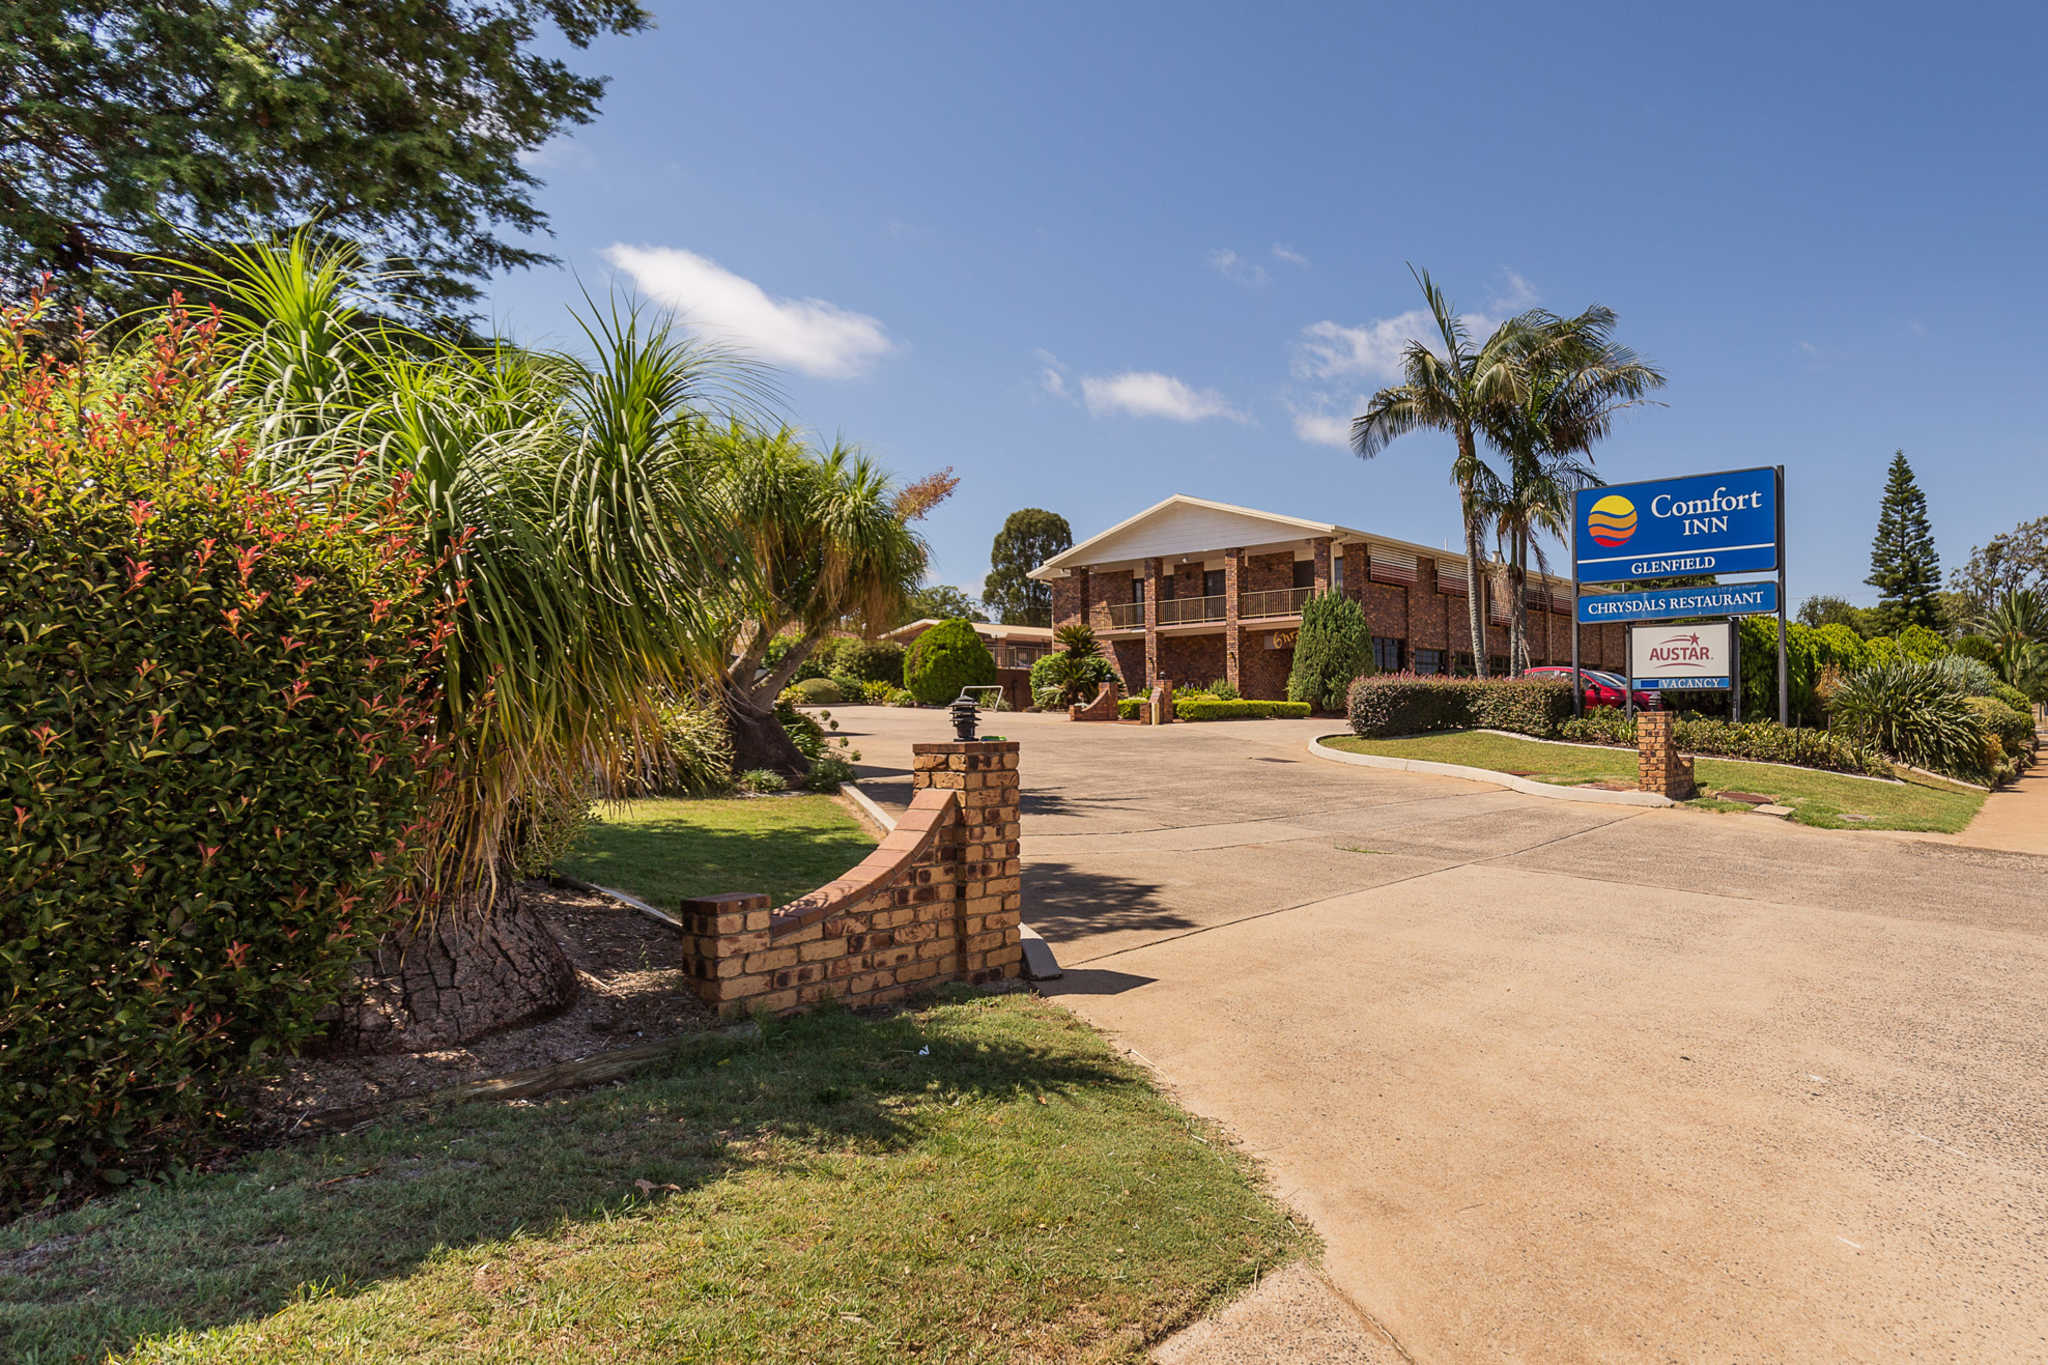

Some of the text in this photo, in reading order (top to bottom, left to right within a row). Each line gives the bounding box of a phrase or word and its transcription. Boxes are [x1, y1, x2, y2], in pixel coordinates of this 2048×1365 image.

[1650, 487, 1762, 518] Comfort
[1683, 516, 1729, 536] INN
[1631, 556, 1716, 574] GLENFIELD
[1588, 591, 1764, 615] CHRYSDALS RESTAURANT
[1649, 646, 1710, 661] AUSTAR
[1661, 678, 1720, 689] VACANCY
